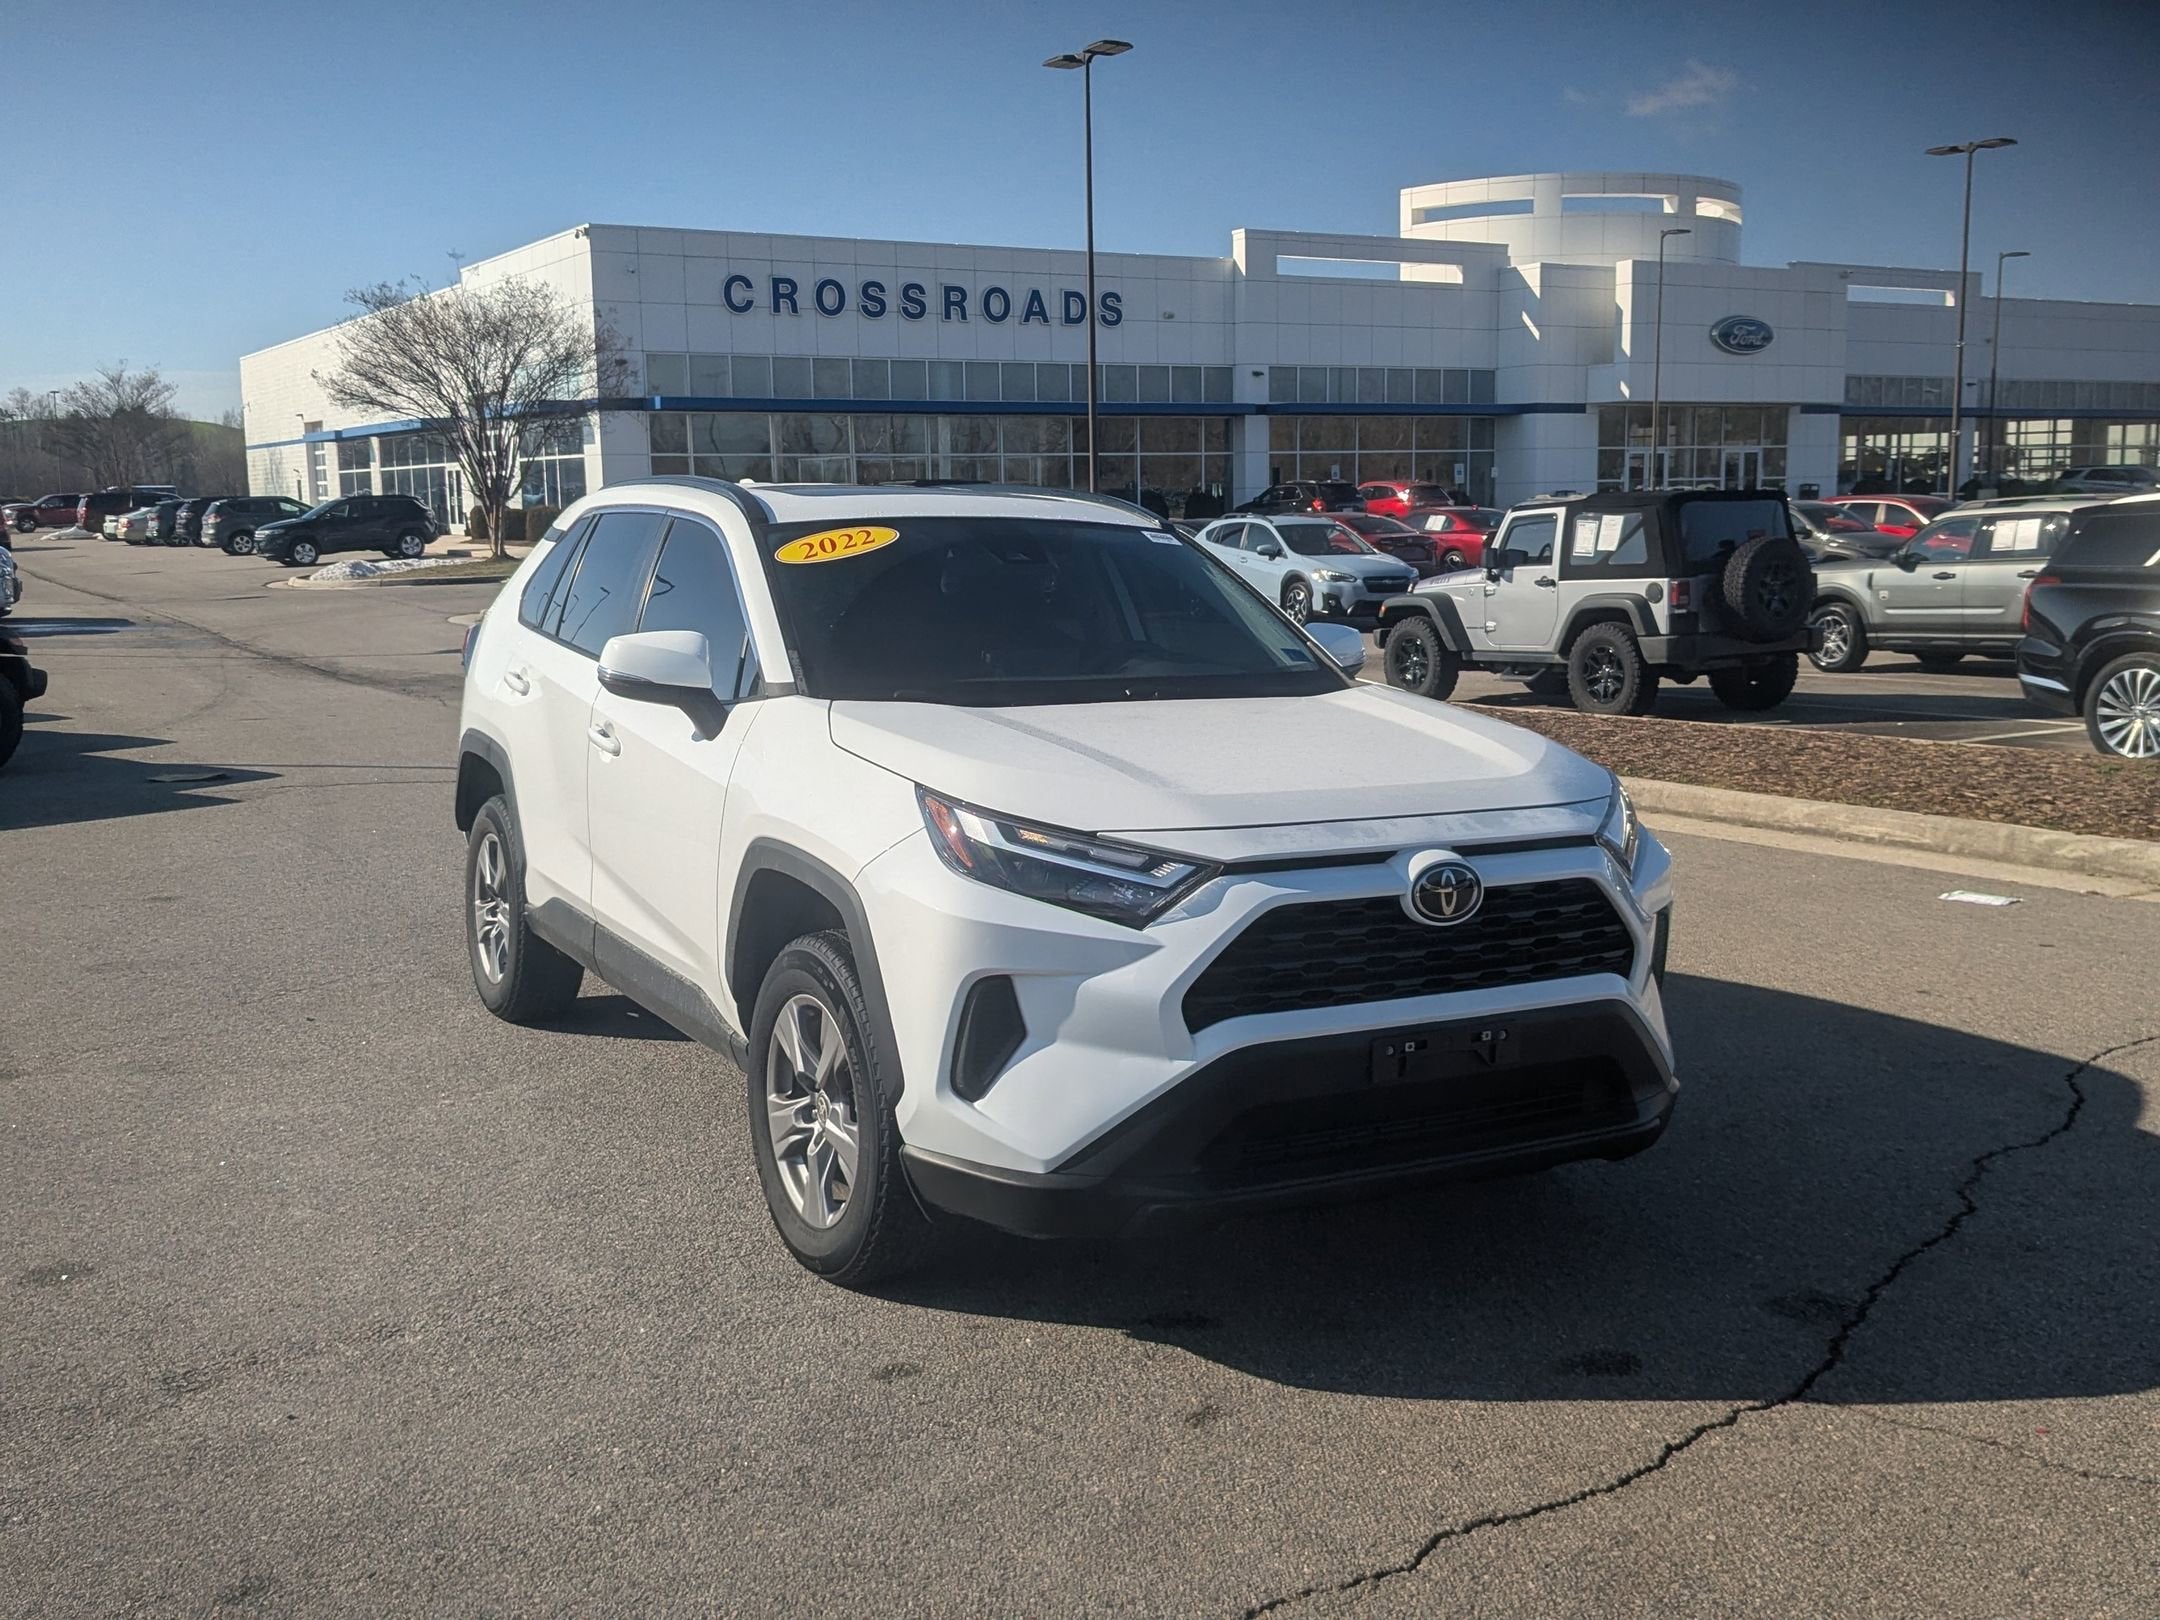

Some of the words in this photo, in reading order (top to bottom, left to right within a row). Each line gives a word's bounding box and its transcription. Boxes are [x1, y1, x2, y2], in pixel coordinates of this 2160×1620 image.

[723, 274, 1123, 327] CROSSROADS
[1730, 324, 1766, 345] Ford
[799, 529, 876, 560] 2022
